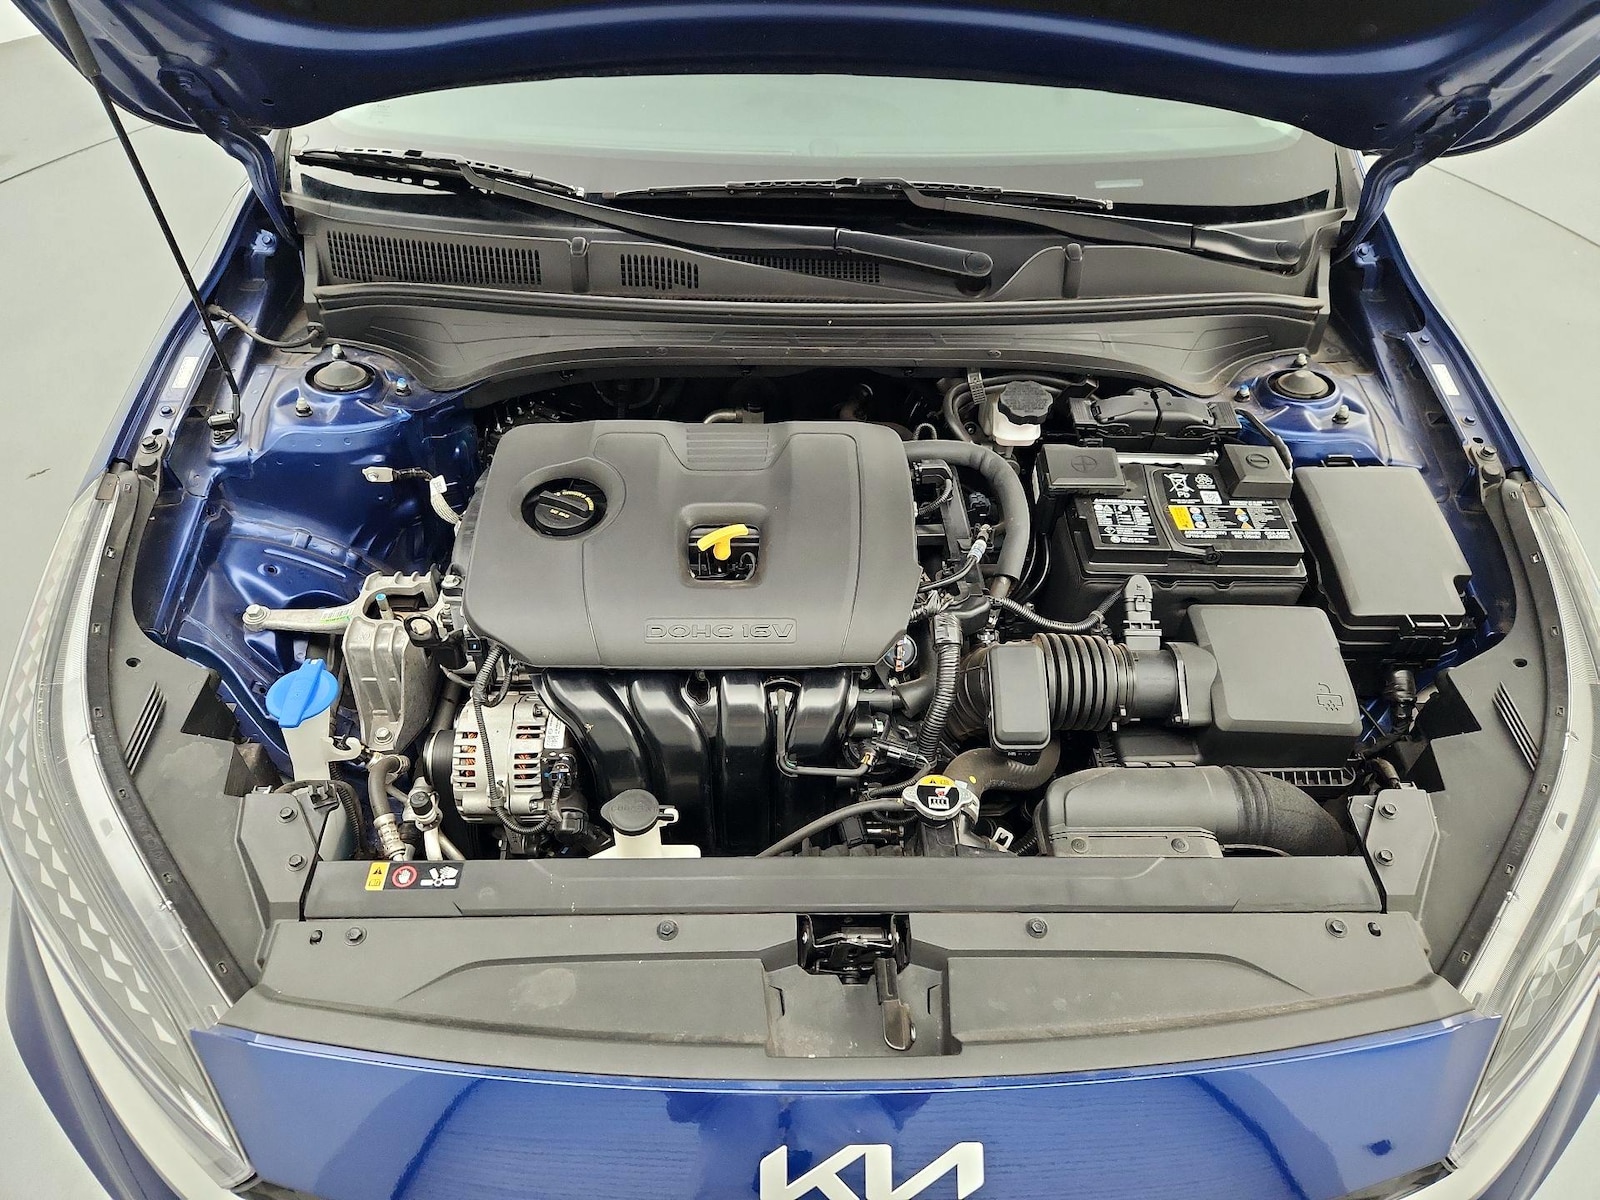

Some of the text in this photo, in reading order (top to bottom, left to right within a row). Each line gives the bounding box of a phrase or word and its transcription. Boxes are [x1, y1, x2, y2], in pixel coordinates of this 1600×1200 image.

[645, 624, 794, 638] DOHC 16V
[759, 1141, 985, 1200] KIA
